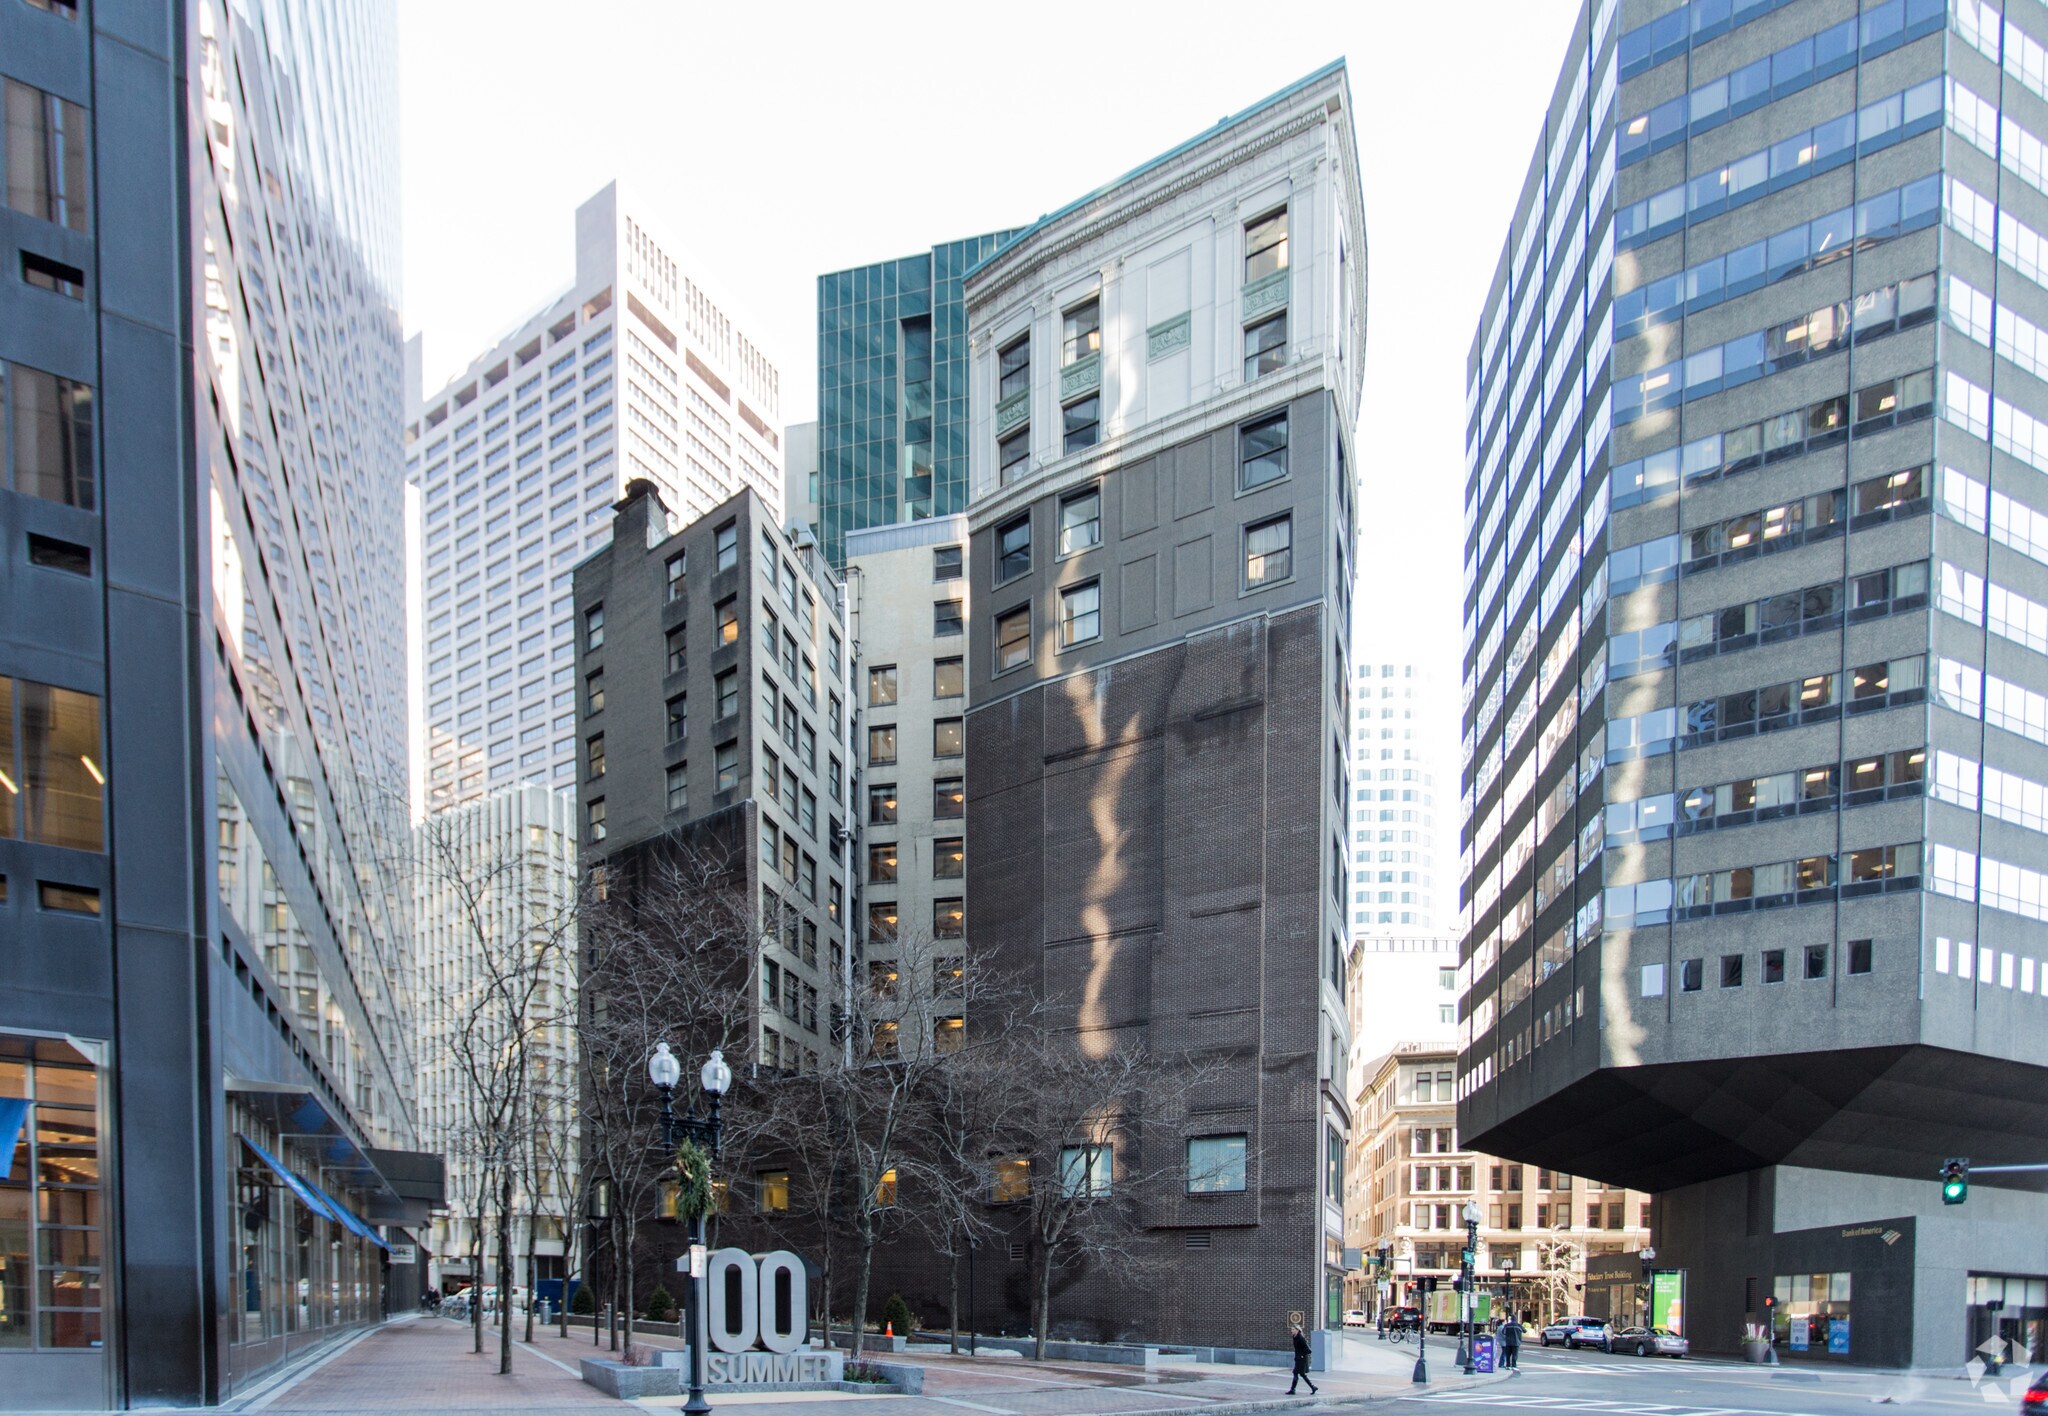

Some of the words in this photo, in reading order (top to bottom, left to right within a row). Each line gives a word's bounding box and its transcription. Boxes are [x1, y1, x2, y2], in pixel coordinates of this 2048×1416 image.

[1841, 1229, 1854, 1238] Bank
[1861, 1226, 1882, 1235] America
[708, 1355, 831, 1383] SUMMER
